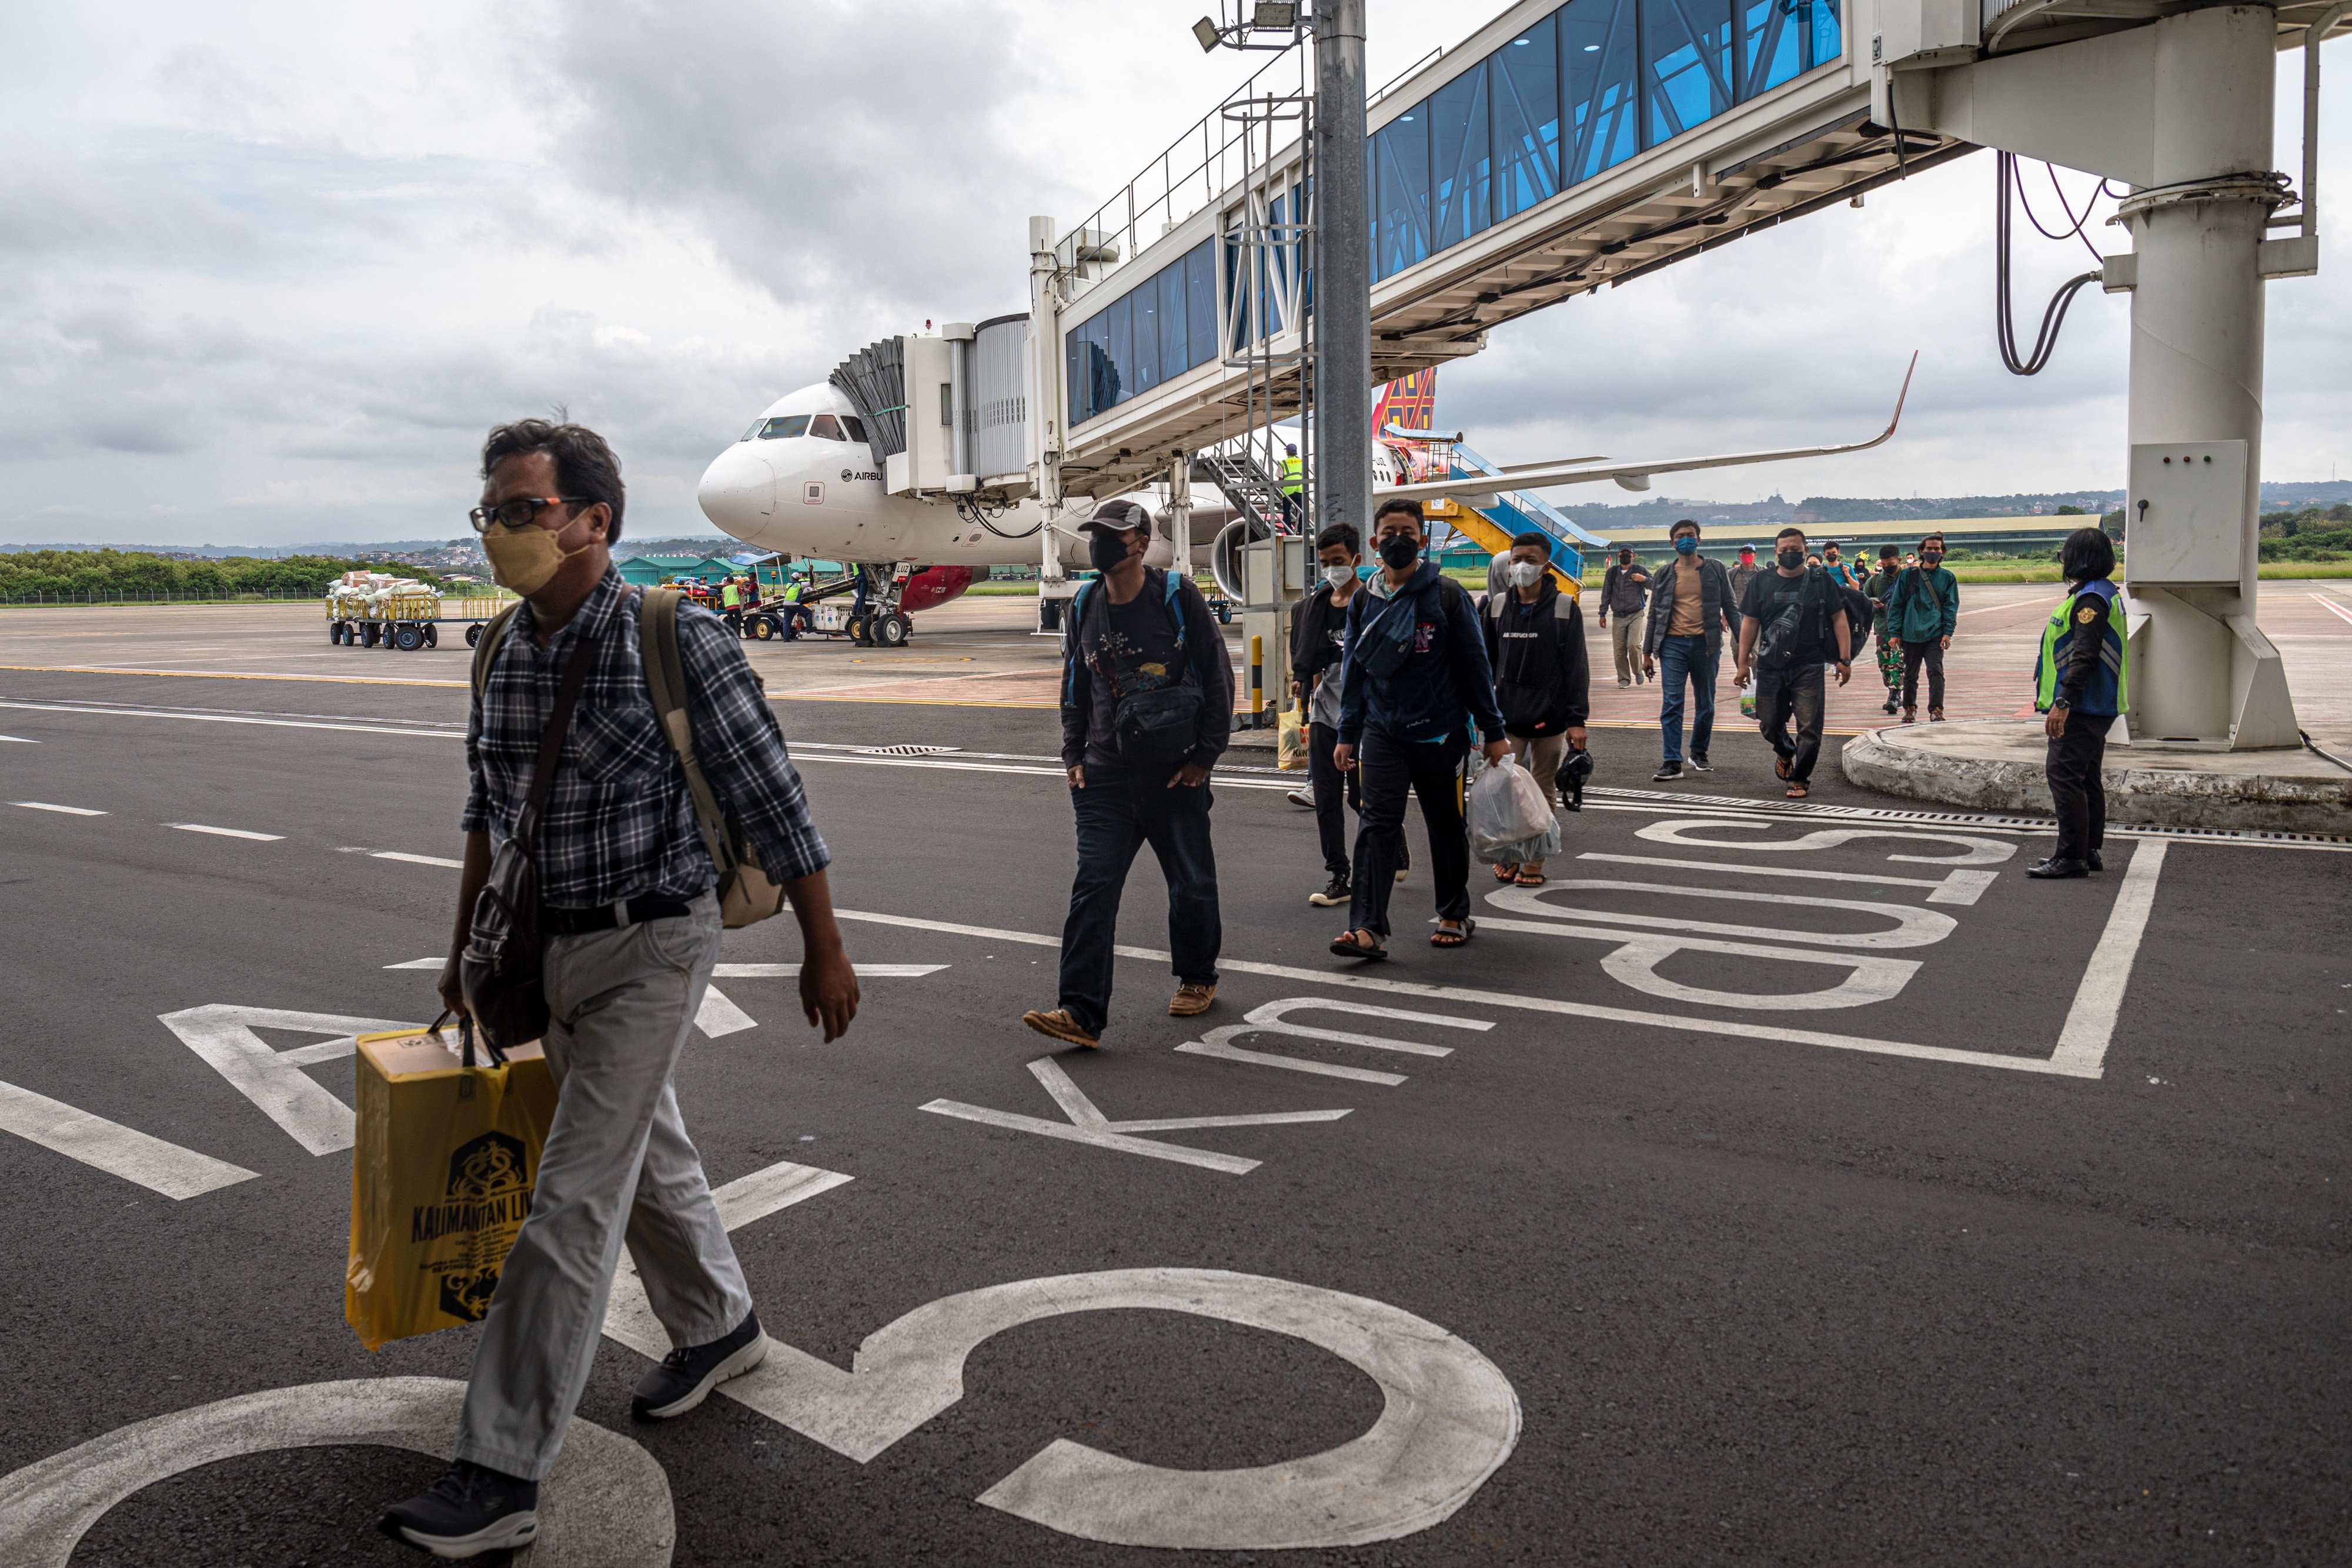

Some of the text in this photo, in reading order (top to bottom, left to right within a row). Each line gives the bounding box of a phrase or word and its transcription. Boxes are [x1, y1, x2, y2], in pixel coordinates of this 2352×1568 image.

[897, 565, 909, 573] LUZ
[1429, 820, 2018, 1011] STOP
[412, 1198, 506, 1243] KALIMANTAN
